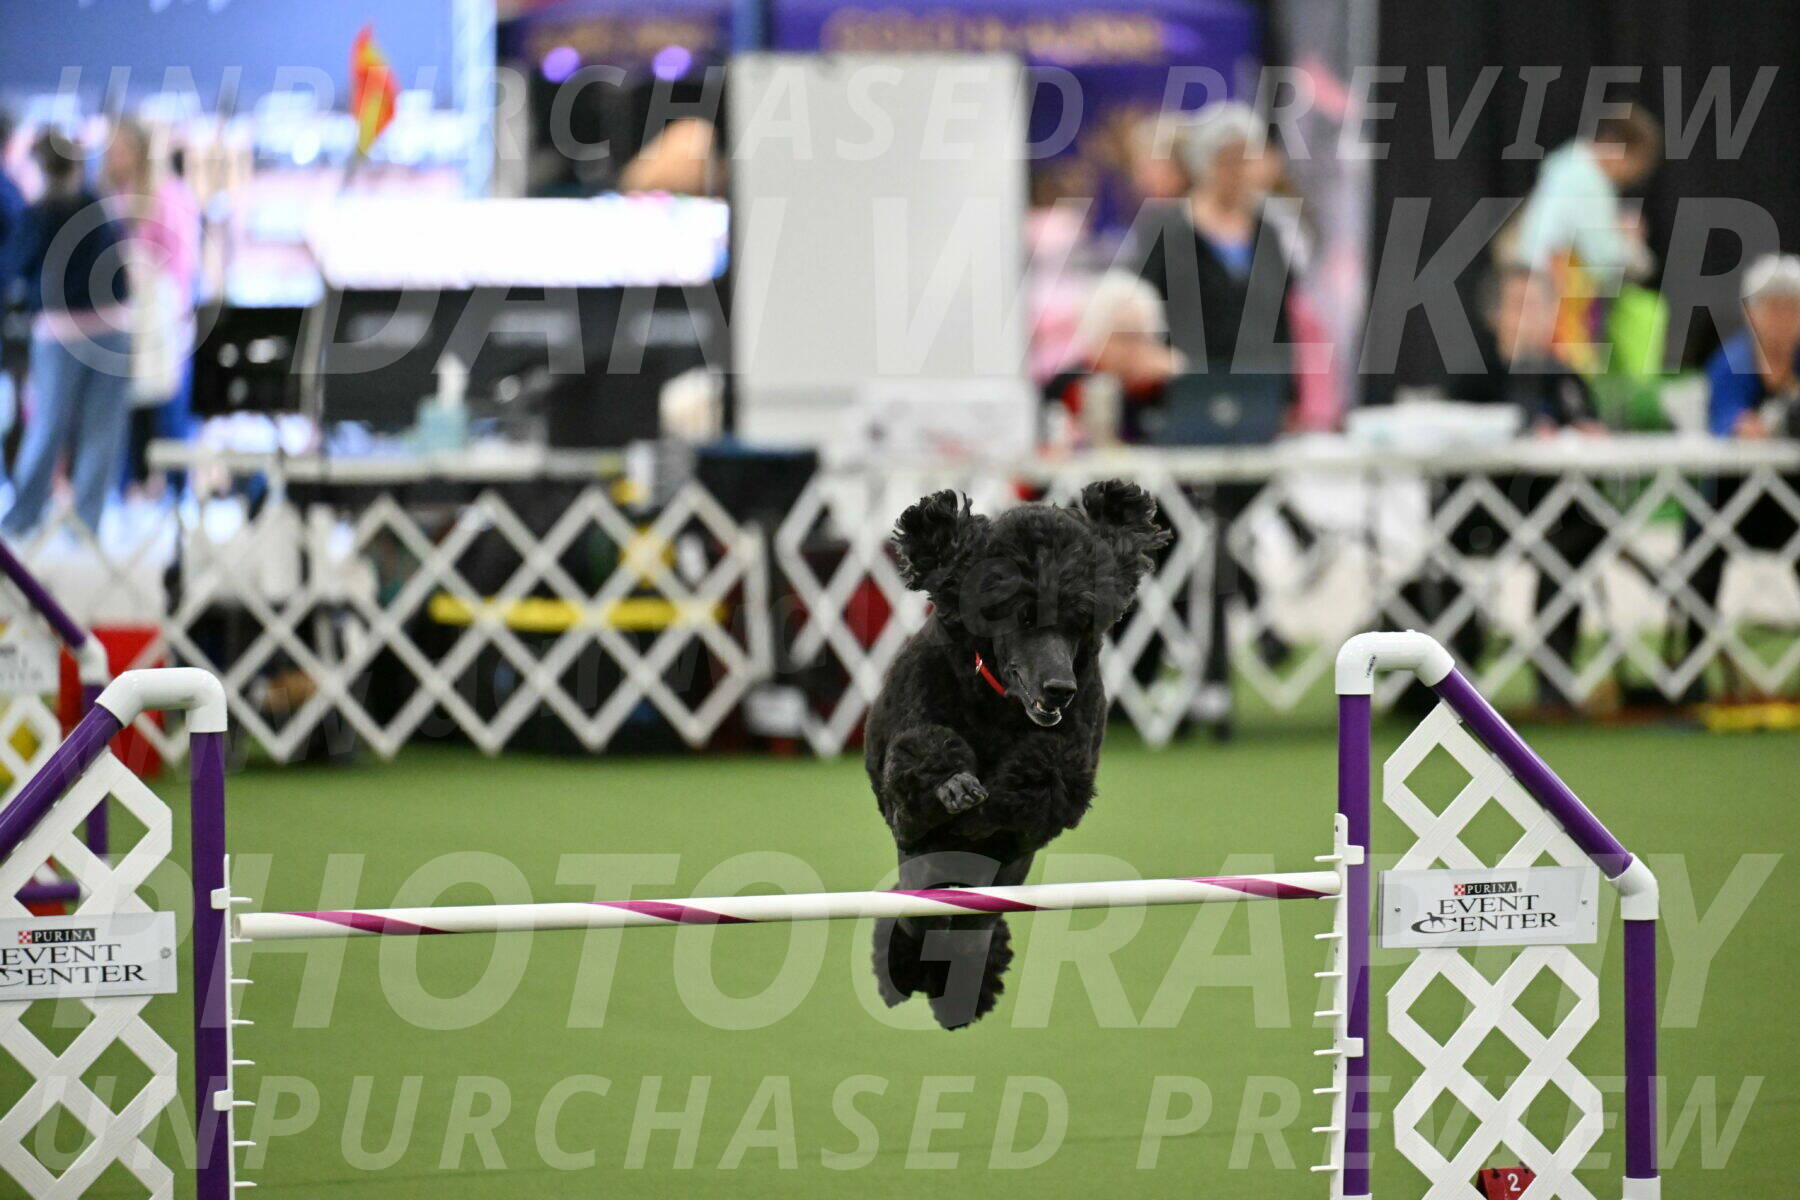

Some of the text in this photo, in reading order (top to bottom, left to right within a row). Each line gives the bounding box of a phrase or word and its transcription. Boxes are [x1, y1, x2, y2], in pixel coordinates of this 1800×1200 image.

[1467, 883, 1514, 894] PURINA
[1439, 894, 1539, 915] EVENT
[1411, 912, 1560, 934] CENTER
[34, 929, 94, 942] PURINA
[0, 944, 121, 966] EVENT
[1507, 1173, 1521, 1191] 2
